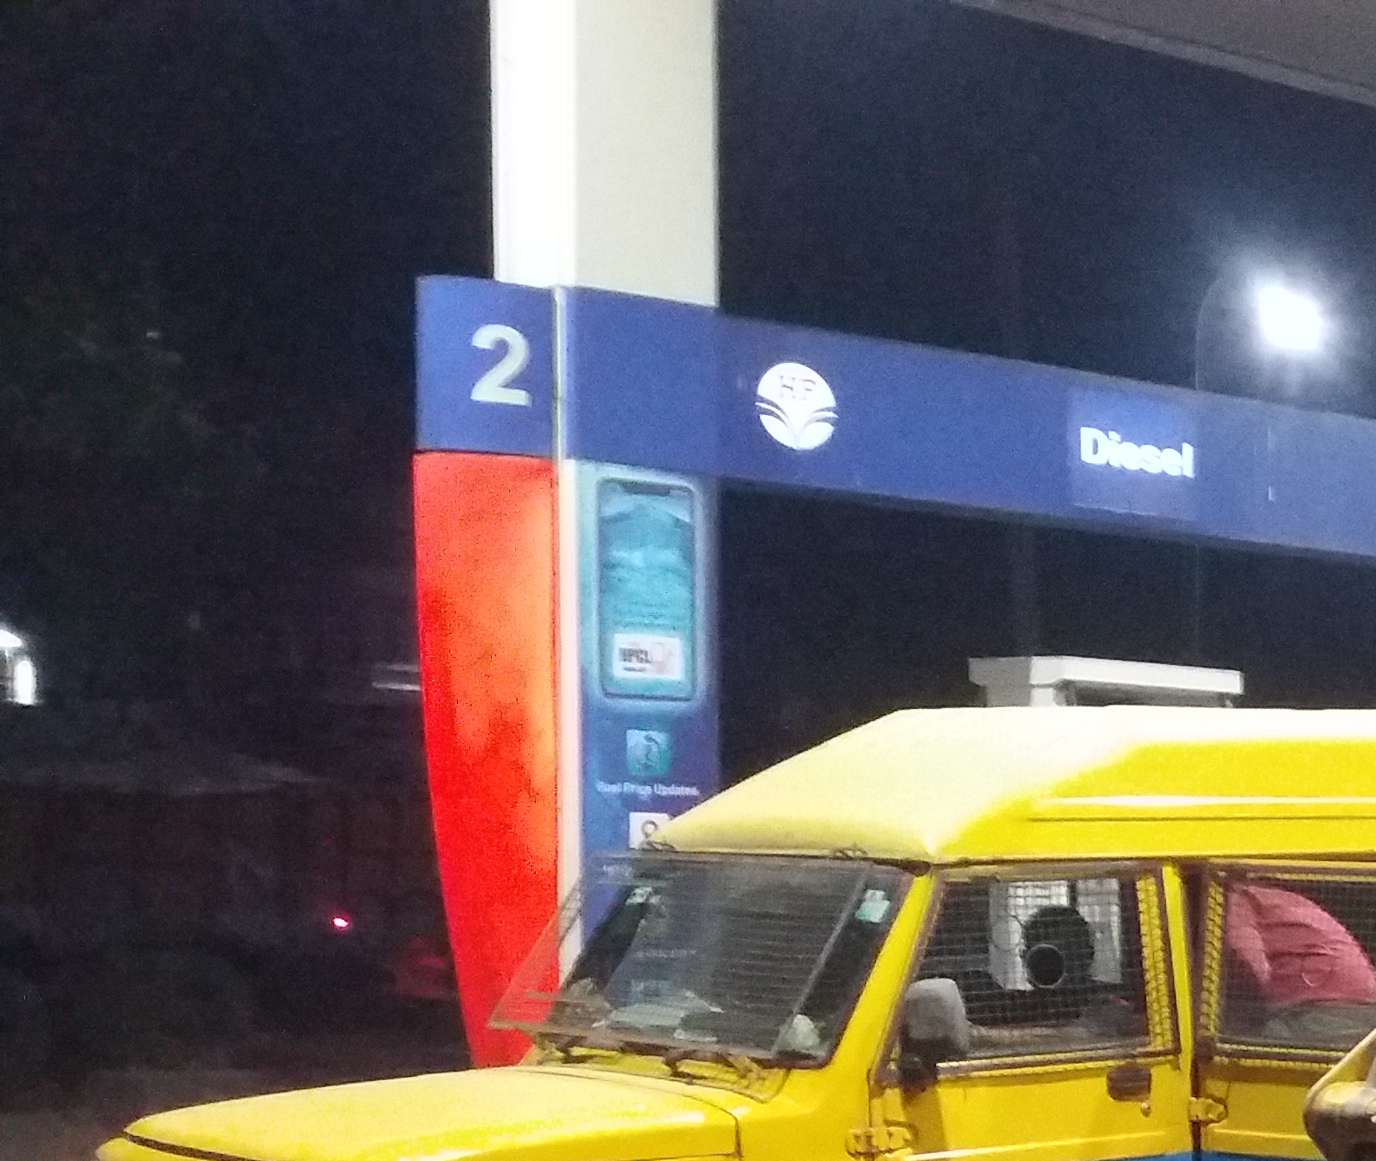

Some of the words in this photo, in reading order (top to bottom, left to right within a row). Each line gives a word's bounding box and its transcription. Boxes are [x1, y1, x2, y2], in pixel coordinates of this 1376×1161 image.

[470, 324, 533, 407] 2
[779, 374, 817, 401] HP
[1080, 426, 1195, 479] Diesel
